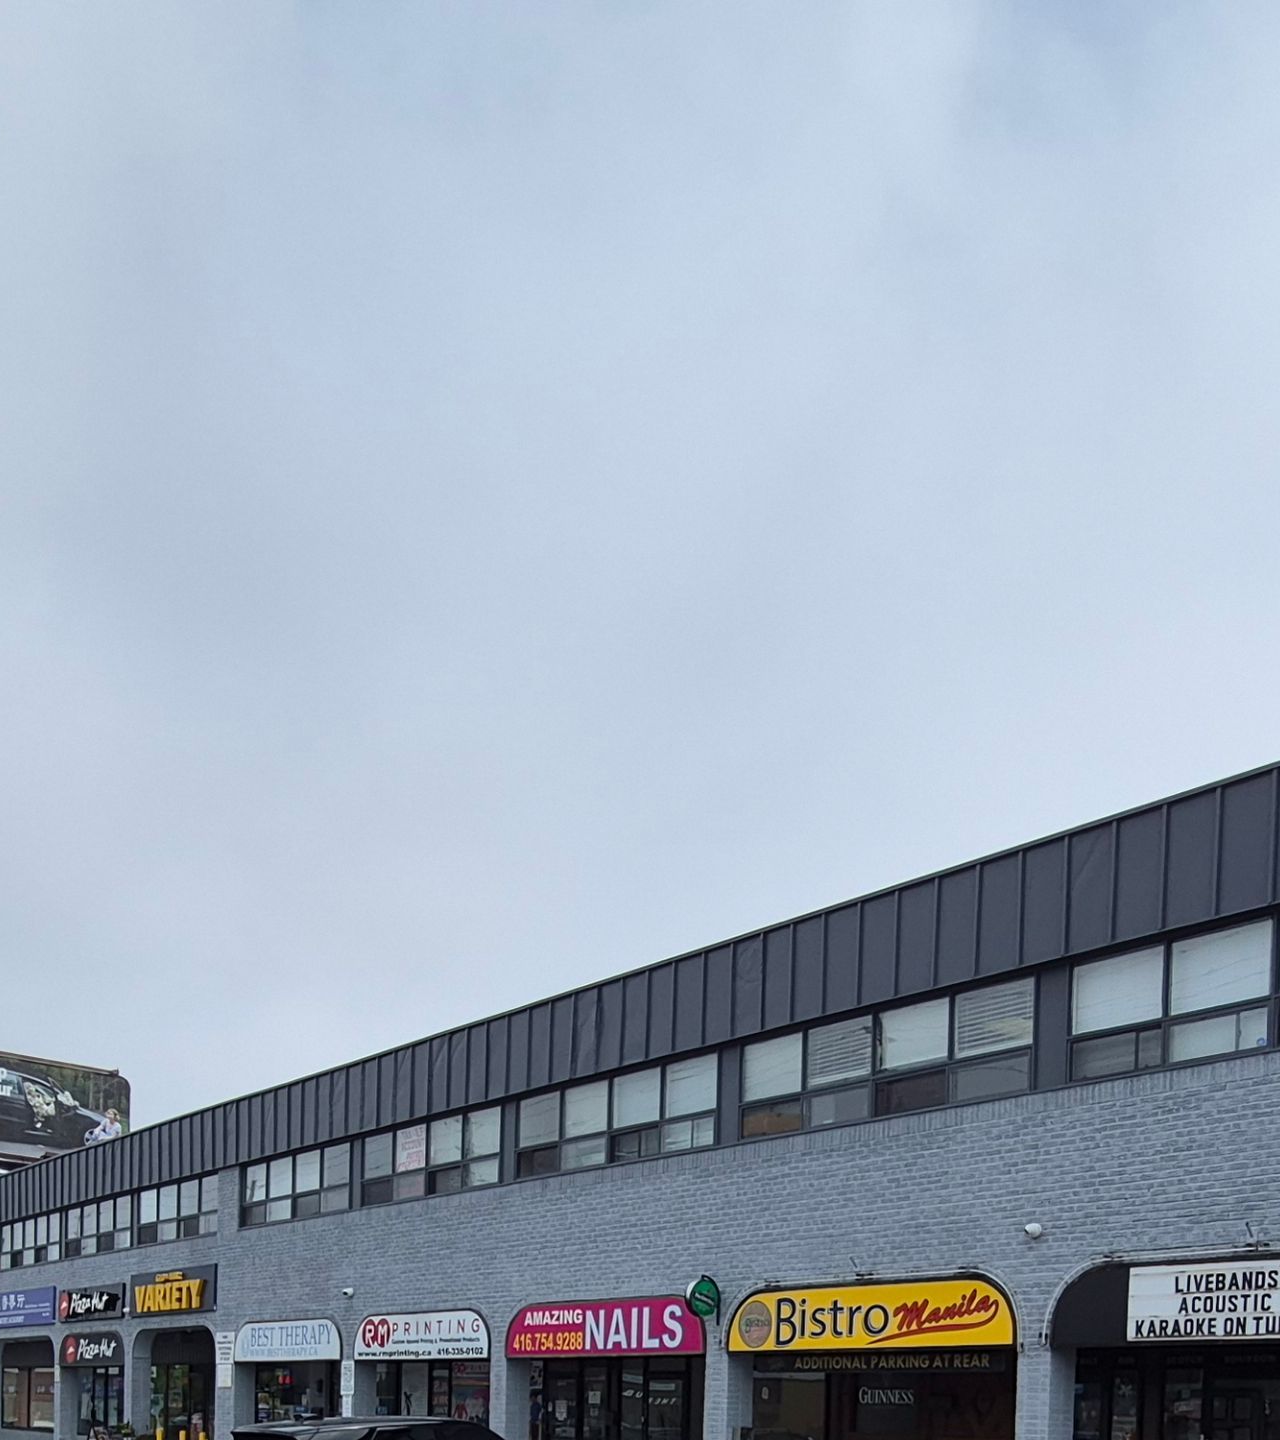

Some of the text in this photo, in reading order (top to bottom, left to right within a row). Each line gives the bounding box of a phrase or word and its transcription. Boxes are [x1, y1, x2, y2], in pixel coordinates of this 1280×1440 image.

[70, 1291, 109, 1315] Pizza Hut
[134, 1279, 204, 1313] VARIETY
[1178, 1294, 1272, 1315] ACOUSTIC
[524, 1304, 684, 1350] AMAZING NAILS
[774, 1288, 1000, 1348] Bistro Manila
[1135, 1317, 1217, 1338] KARAOKE
[1224, 1316, 1248, 1336] ON
[251, 1324, 333, 1347] BEST THERAPY
[363, 1318, 480, 1348] RM PRINTING
[513, 1332, 584, 1352] 416.754.9288
[77, 1337, 118, 1361] Pizza Hut
[357, 1347, 484, 1358] www.rmprinting.ca 416-335-0102
[794, 1354, 990, 1370] ADDITIONAL PARKING AT REAR
